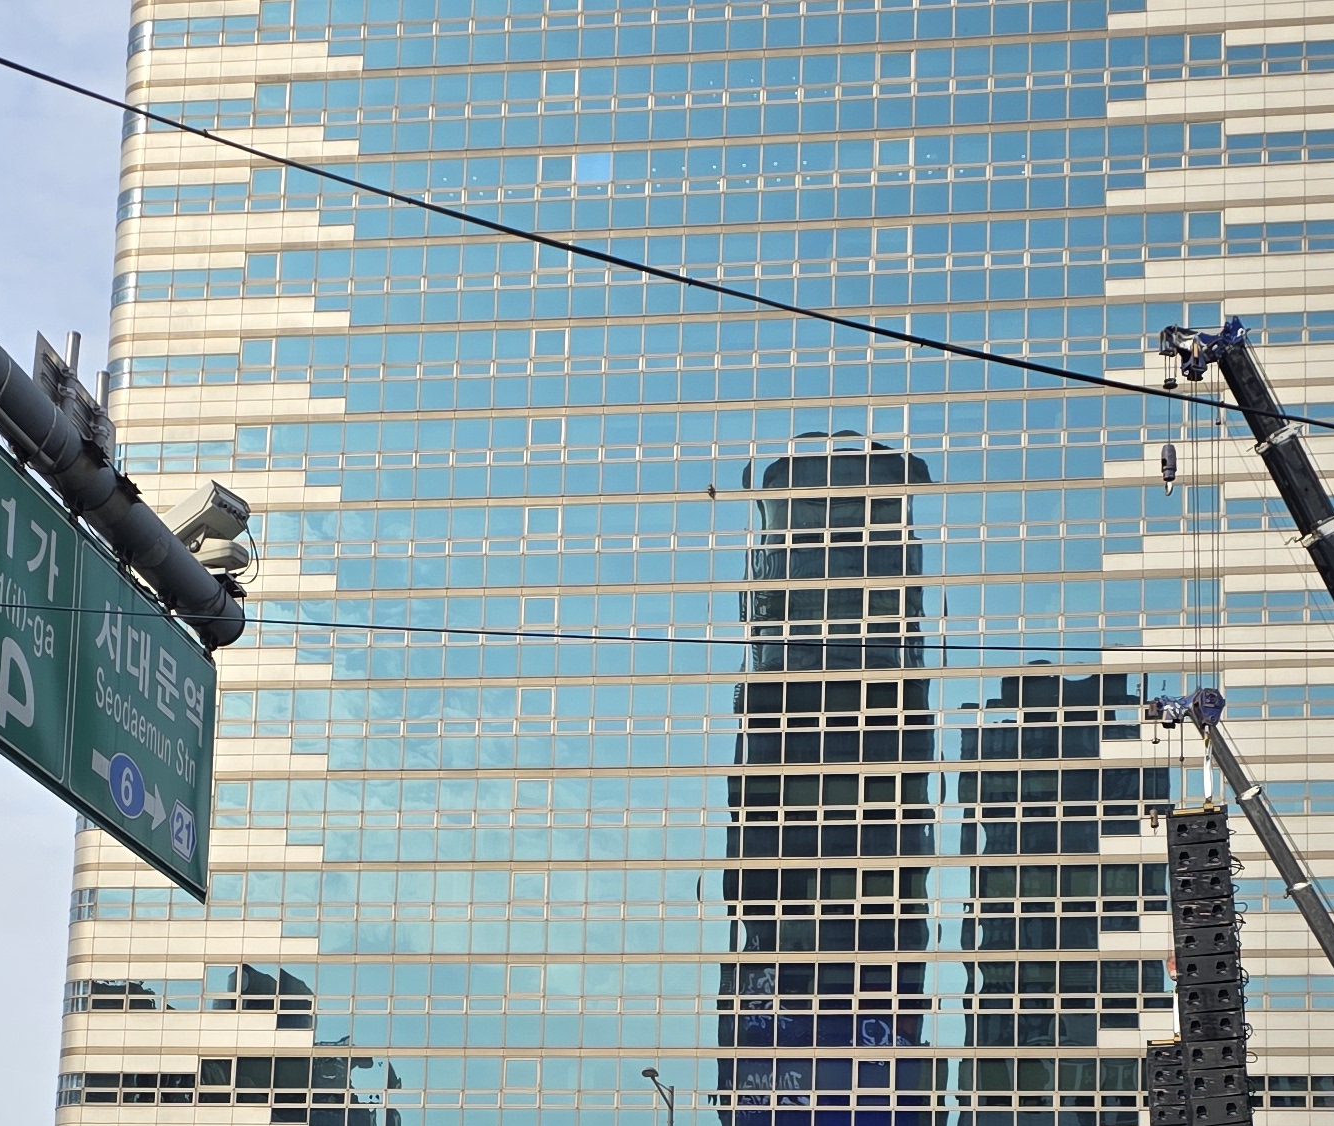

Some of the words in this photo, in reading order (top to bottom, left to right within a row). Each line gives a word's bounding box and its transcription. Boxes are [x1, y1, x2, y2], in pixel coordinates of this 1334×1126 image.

[95, 600, 205, 747] 서대문역
[95, 666, 171, 767] Seodaemun
[176, 738, 196, 788] Stn
[121, 766, 134, 807] 6
[175, 811, 193, 850] 21
